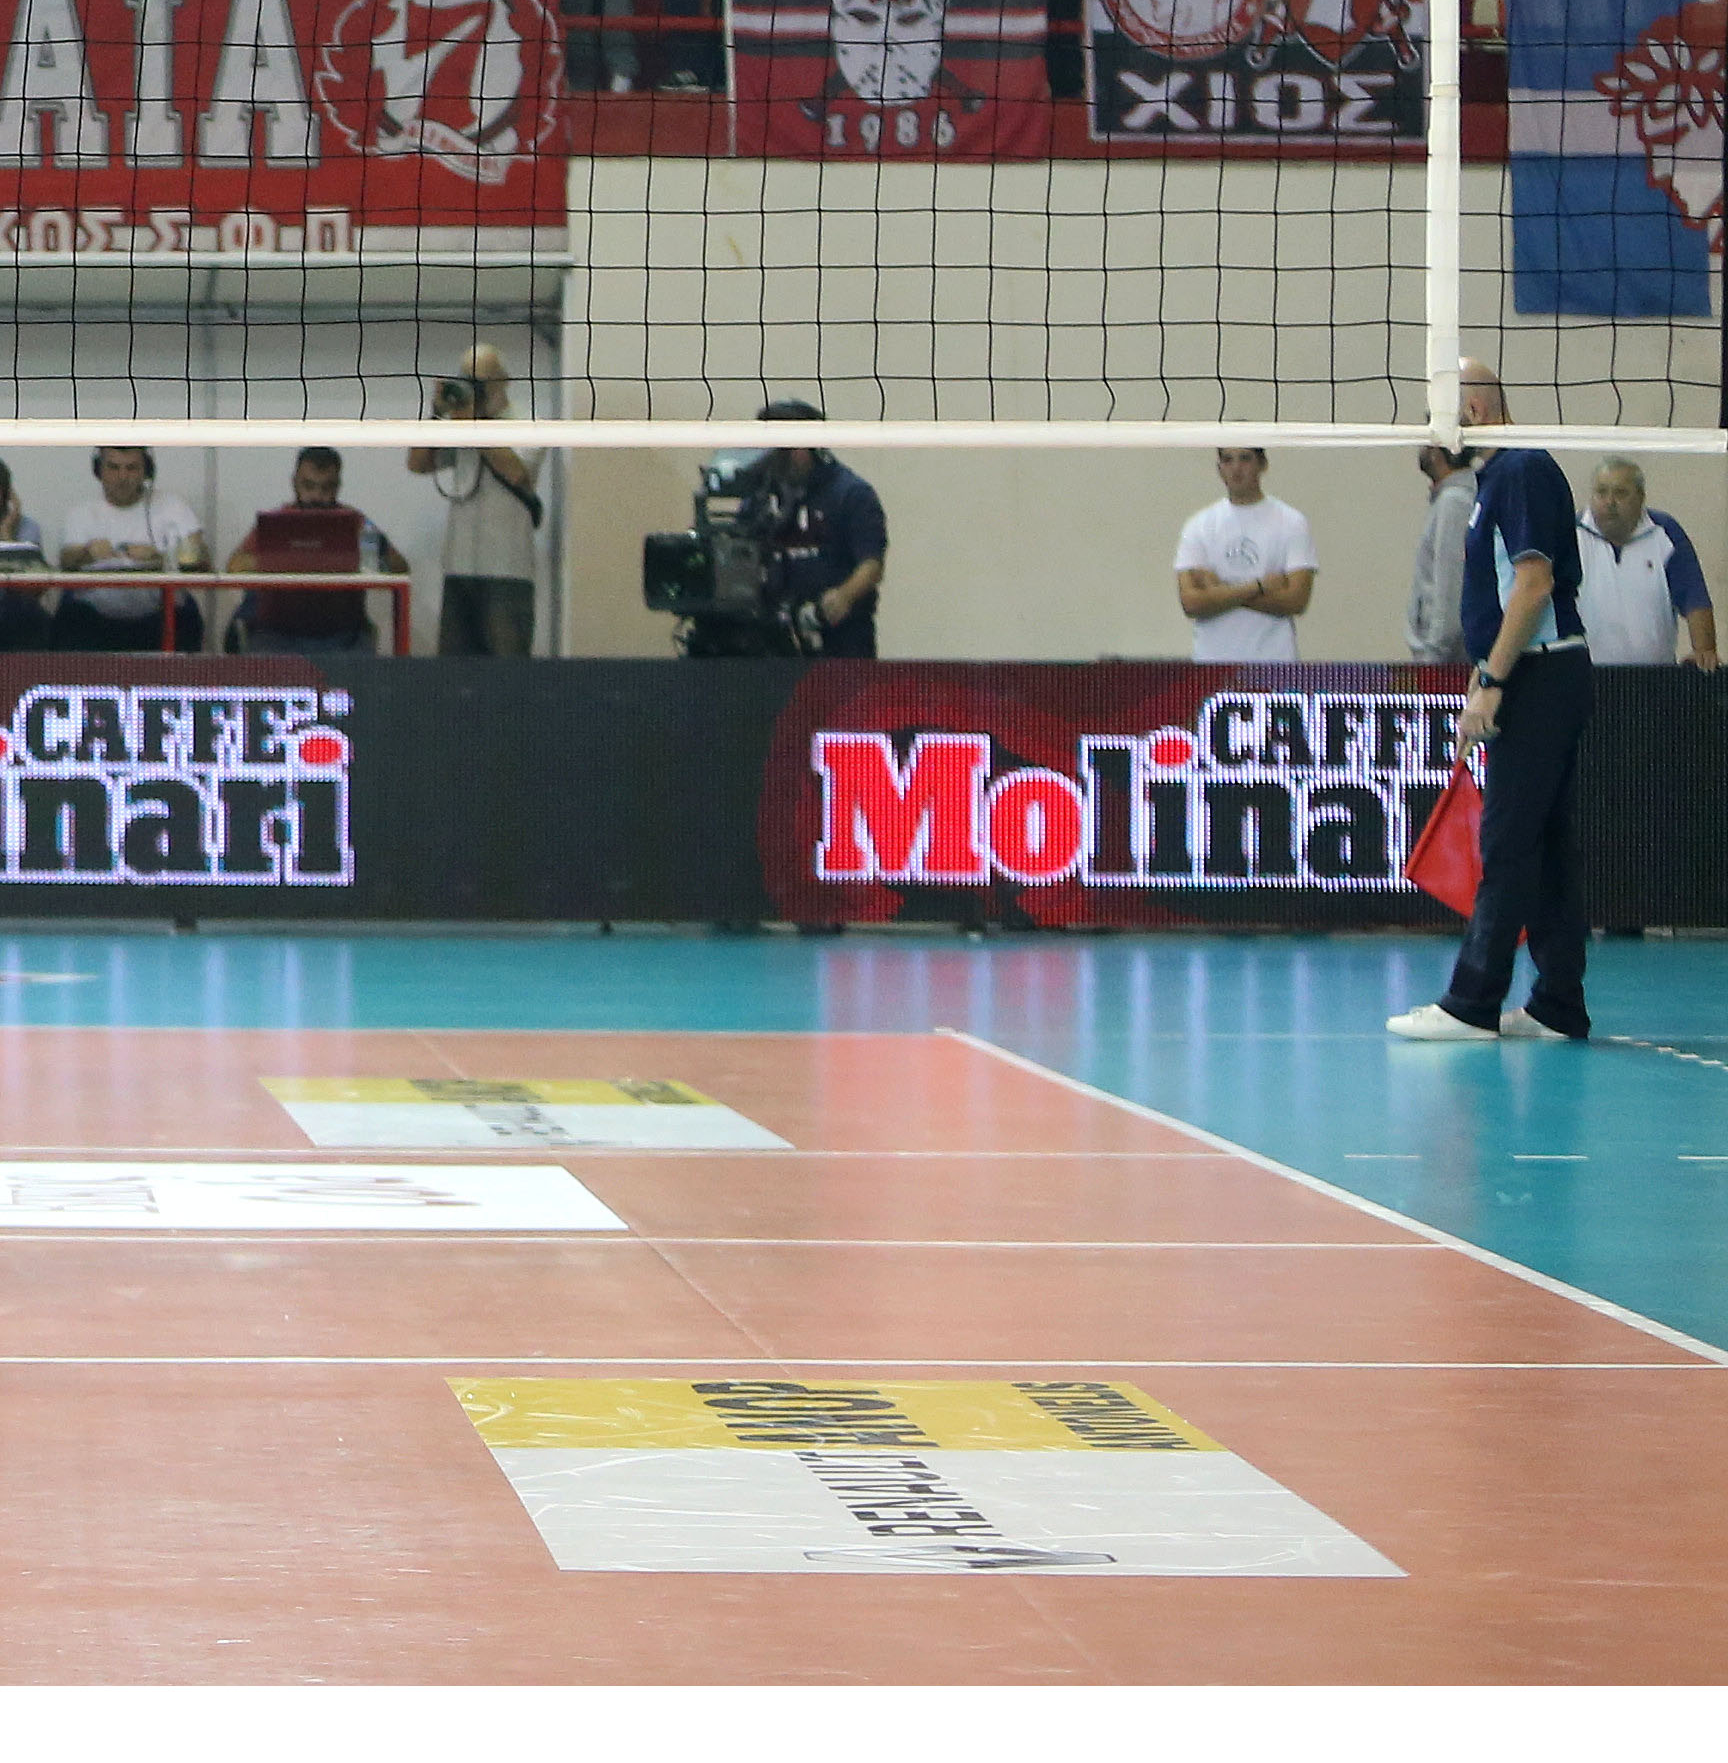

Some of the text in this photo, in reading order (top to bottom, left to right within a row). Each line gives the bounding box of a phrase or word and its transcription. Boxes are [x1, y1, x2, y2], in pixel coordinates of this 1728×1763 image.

[1115, 71, 1398, 133] ΧΙΟΣ
[815, 726, 1437, 891] Molina
[796, 1451, 1004, 1537] RENAULT
